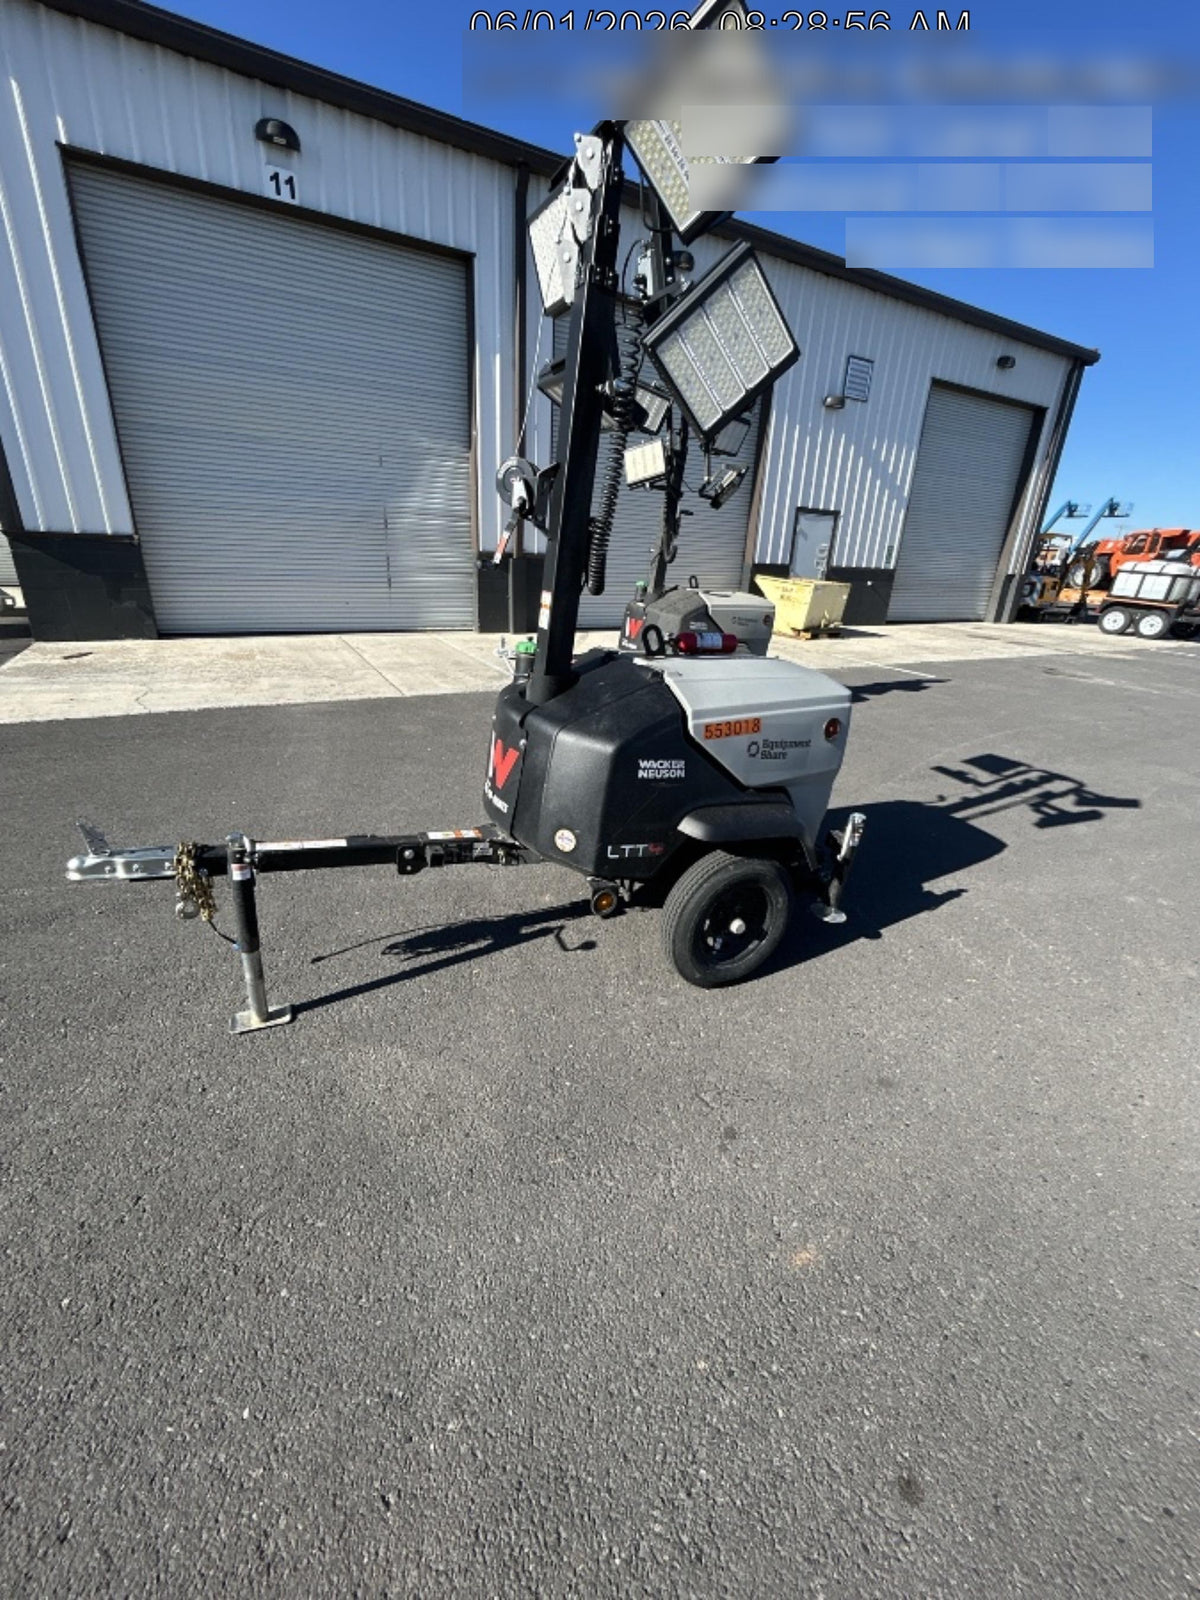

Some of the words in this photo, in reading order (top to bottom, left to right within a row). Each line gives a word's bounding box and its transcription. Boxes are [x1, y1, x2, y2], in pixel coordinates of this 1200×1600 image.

[269, 171, 296, 200] 11
[705, 717, 761, 740] 553018
[760, 749, 788, 760] Share
[638, 769, 685, 779] NEUSON
